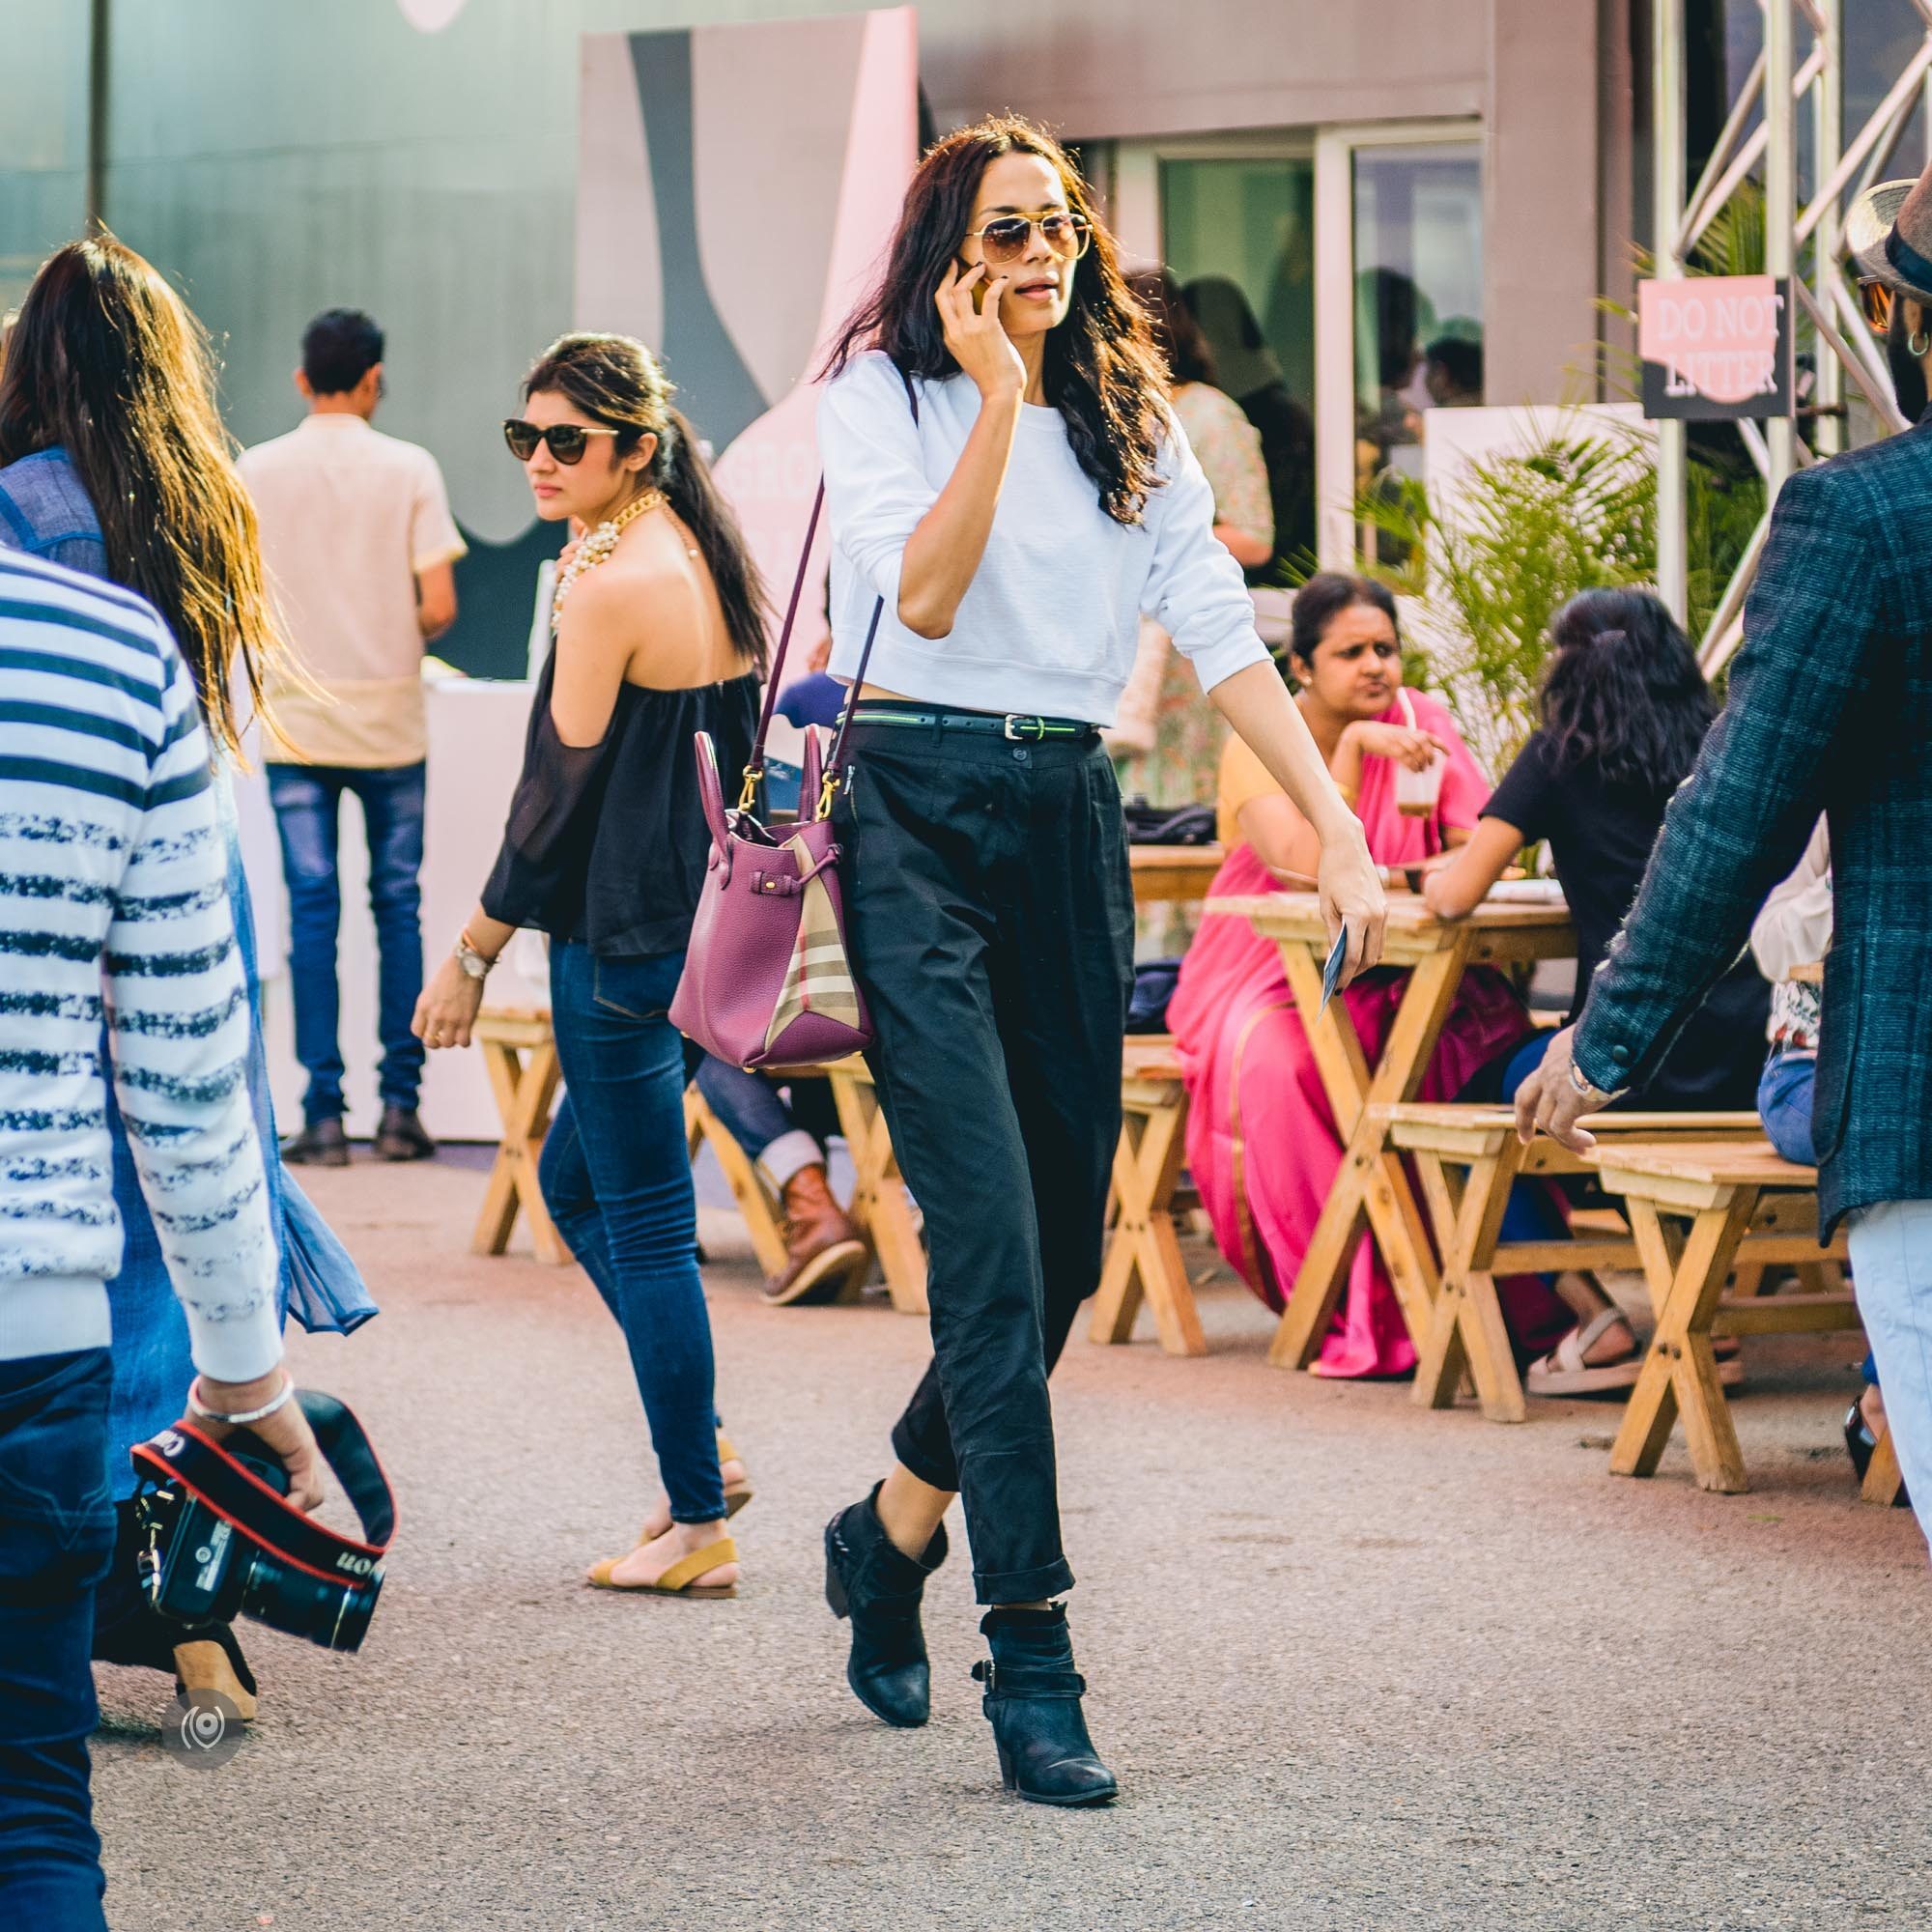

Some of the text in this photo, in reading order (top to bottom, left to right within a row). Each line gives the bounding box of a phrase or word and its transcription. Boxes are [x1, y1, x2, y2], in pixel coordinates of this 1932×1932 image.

[1657, 295, 1785, 341] DO NOT
[1664, 350, 1778, 397] LITTER
